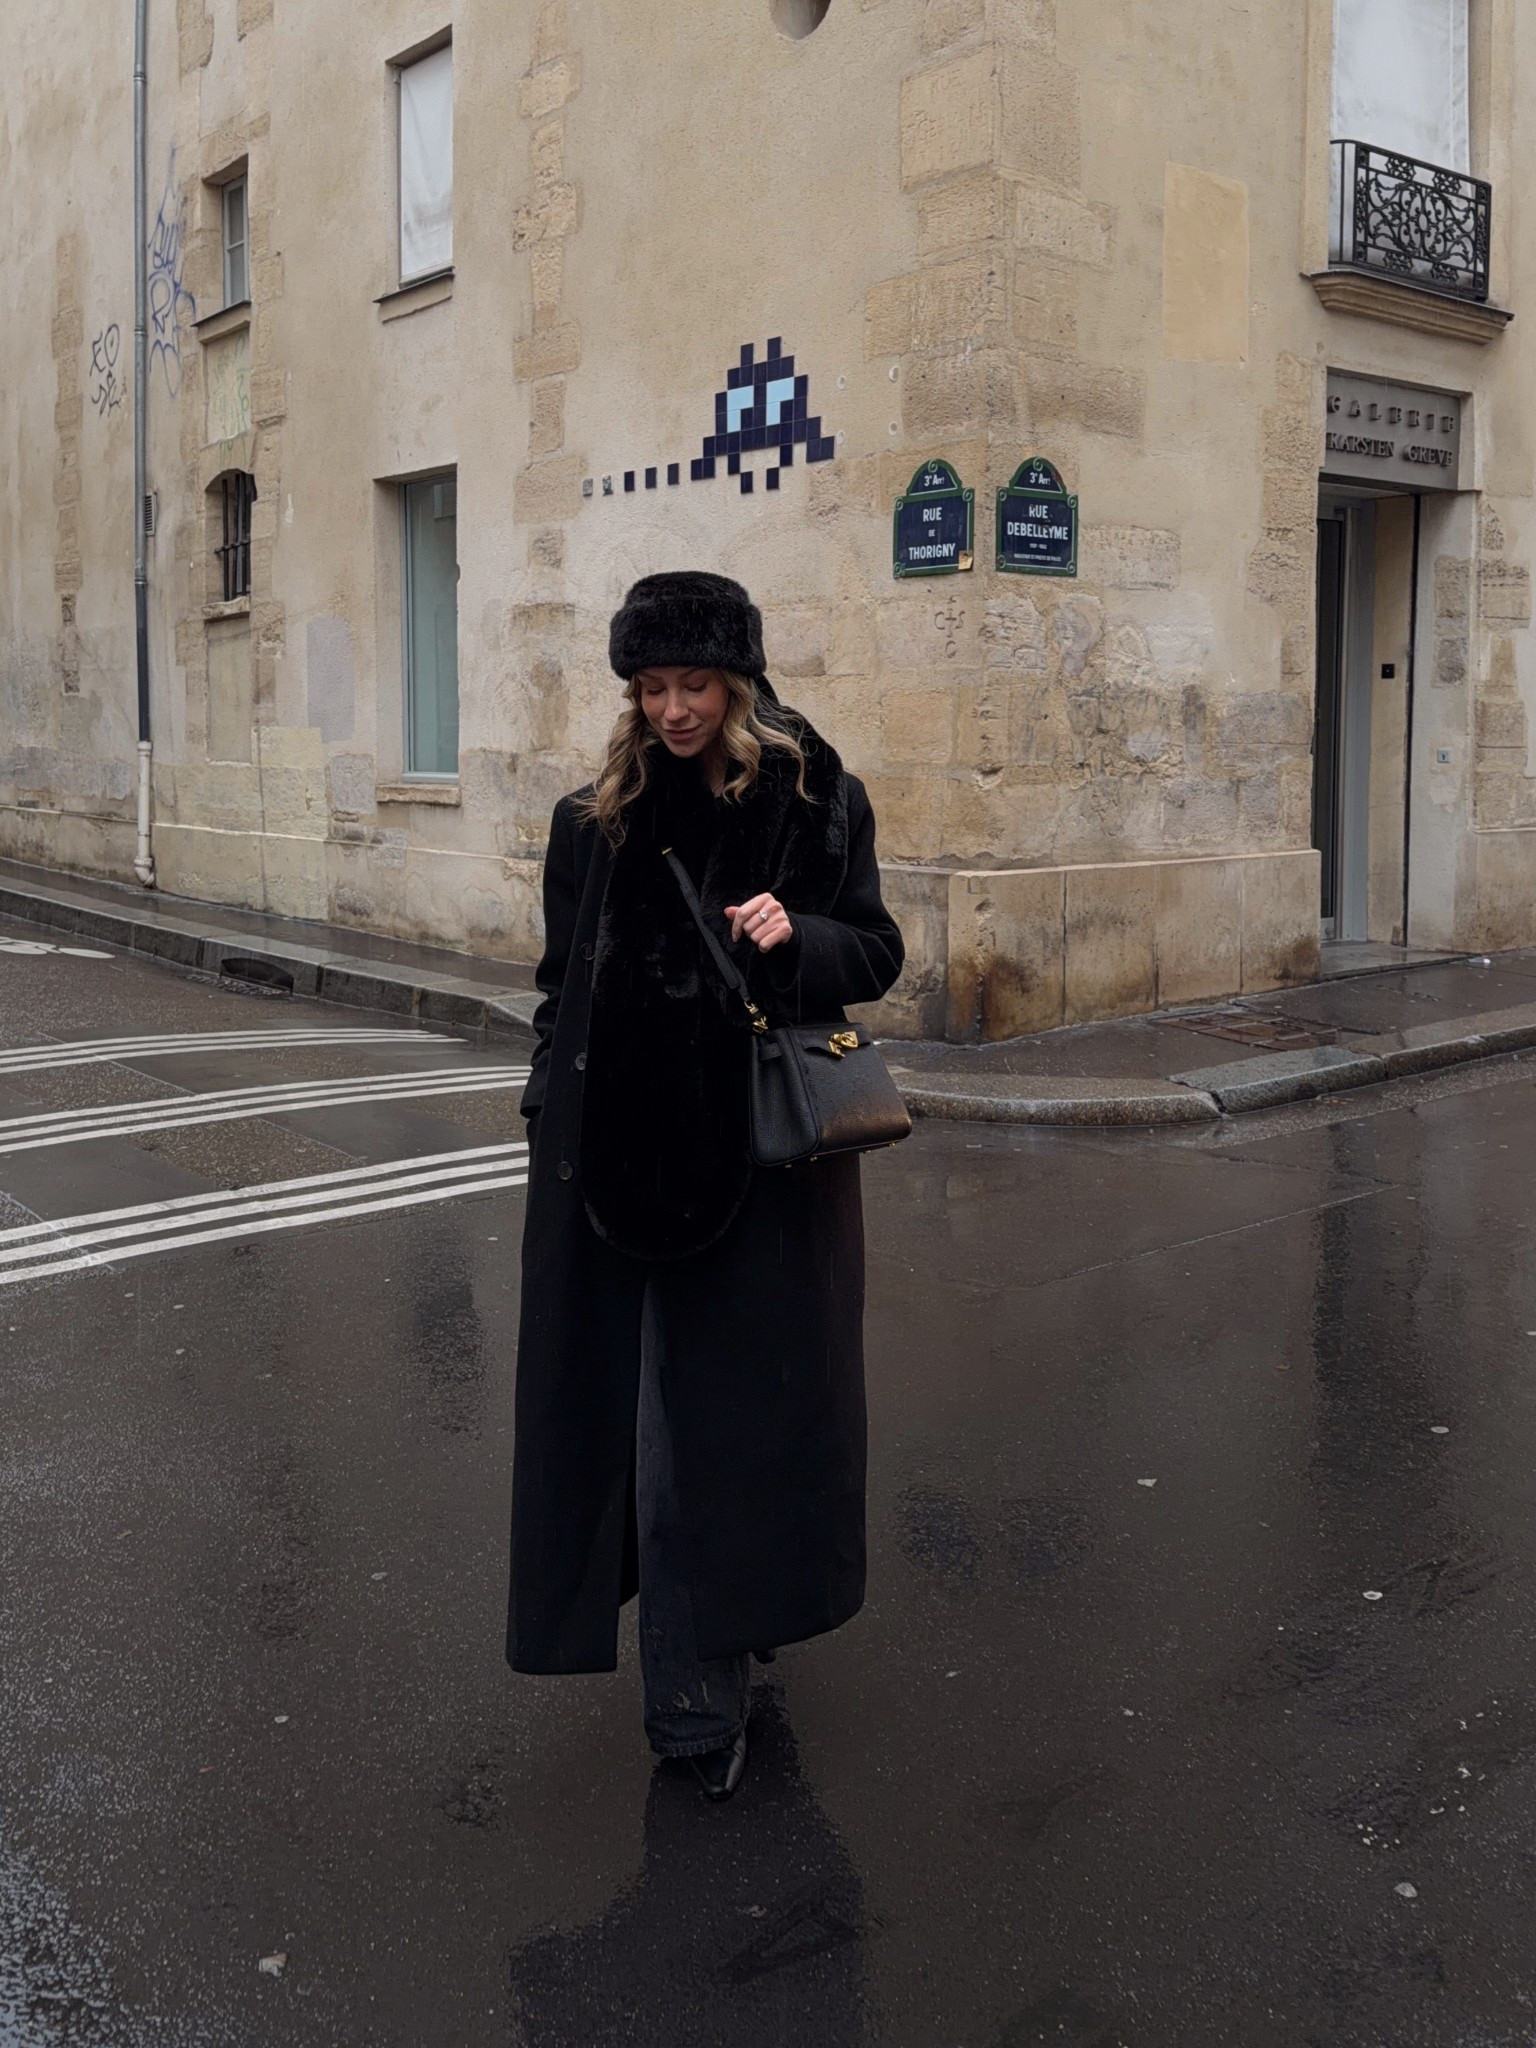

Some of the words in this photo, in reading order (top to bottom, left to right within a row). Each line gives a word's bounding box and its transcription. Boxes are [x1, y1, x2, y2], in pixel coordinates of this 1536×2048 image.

[1327, 396, 1454, 433] GALERIE
[1327, 432, 1394, 458] KARSTEN
[1404, 444, 1453, 467] GREVE
[922, 507, 942, 522] RUE
[1029, 505, 1048, 520] RUE
[928, 529, 935, 537] DE
[1007, 521, 1068, 540] DEBELLEYME
[908, 543, 956, 560] THORIGNY
